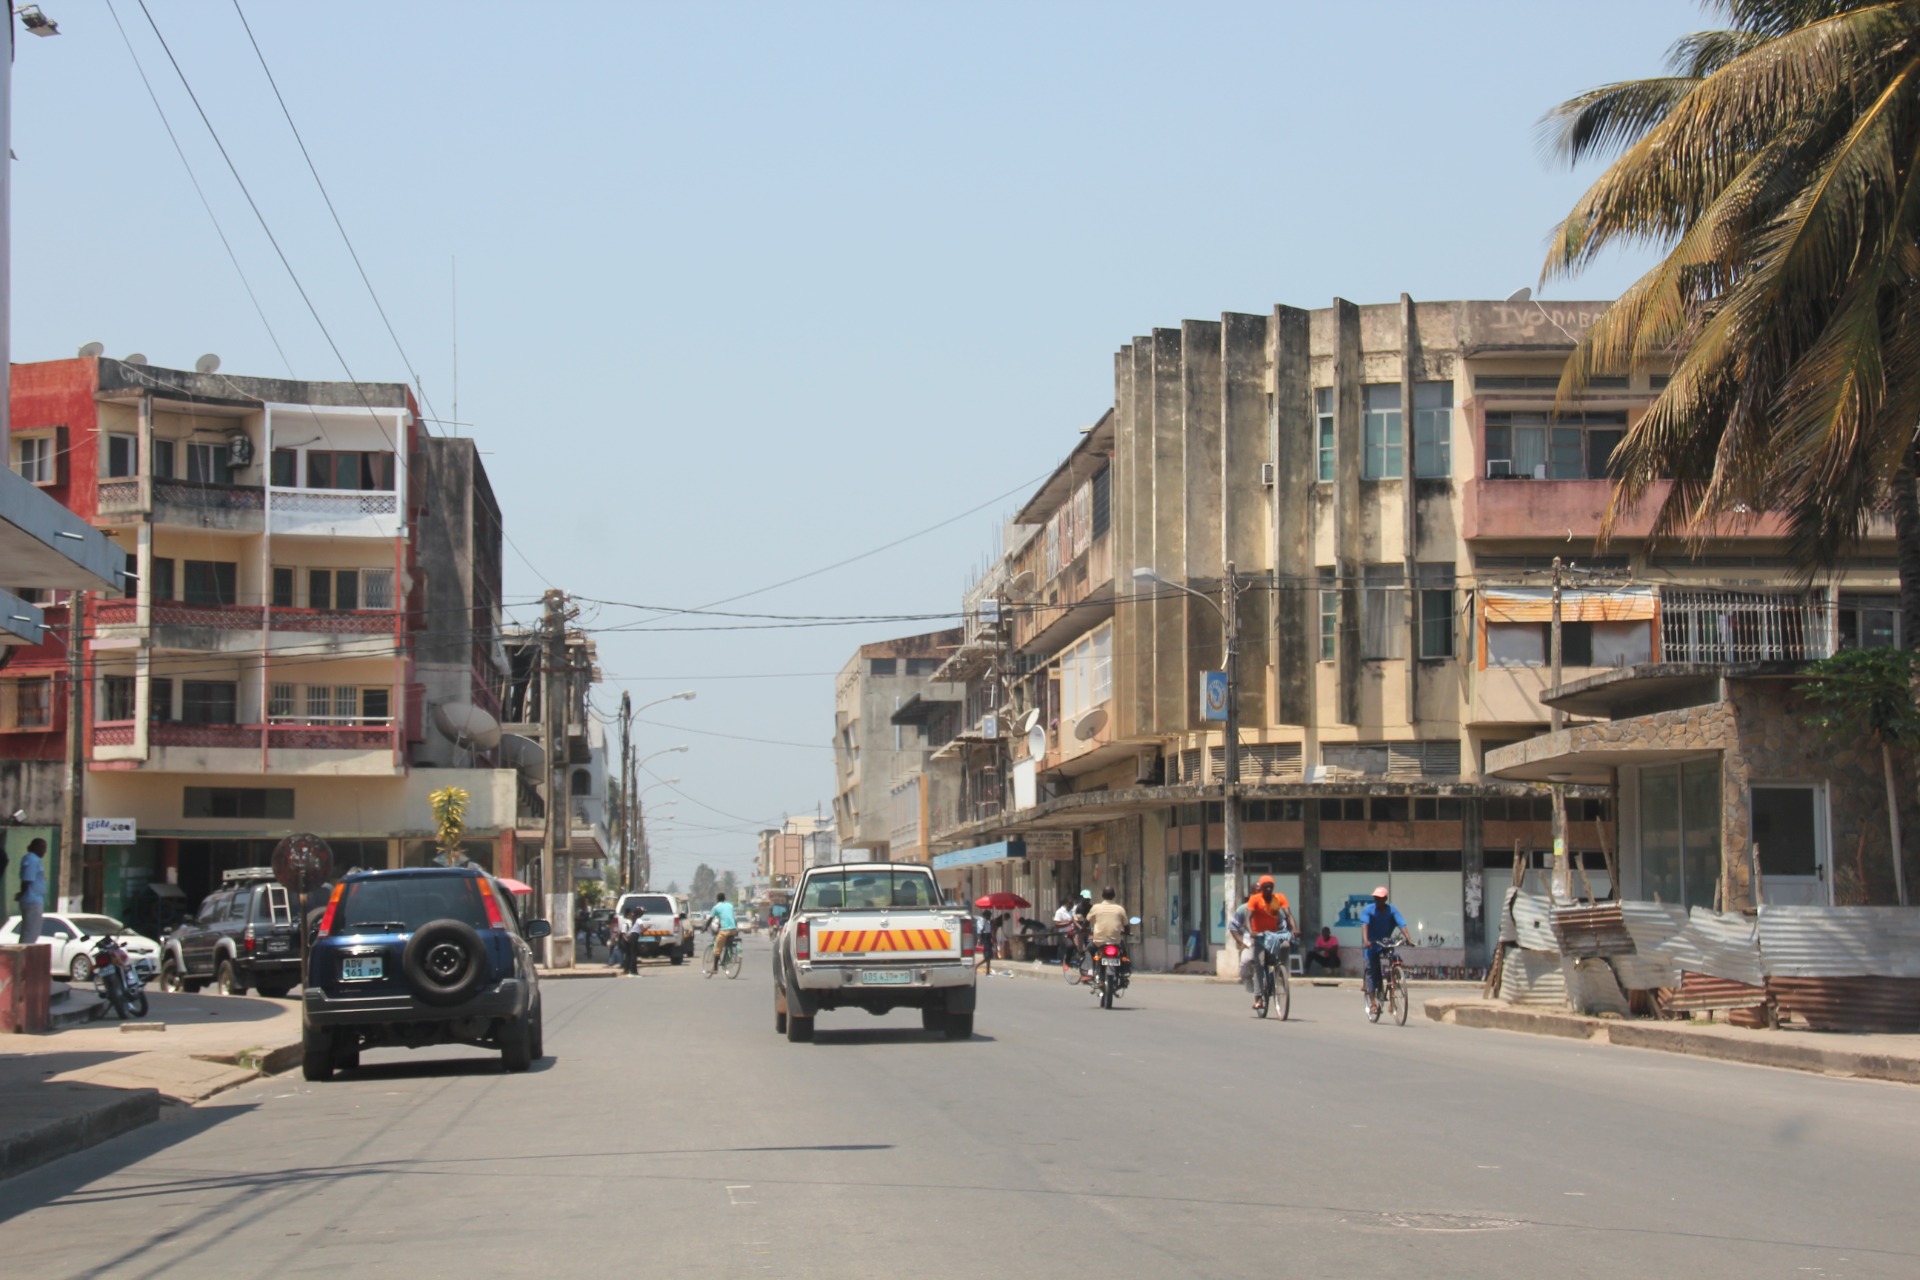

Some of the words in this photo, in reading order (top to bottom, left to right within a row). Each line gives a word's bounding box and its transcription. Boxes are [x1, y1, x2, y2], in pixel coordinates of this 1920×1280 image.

[1490, 306, 1546, 328] IVO
[87, 819, 110, 832] SEGRA
[345, 968, 363, 977] 161
